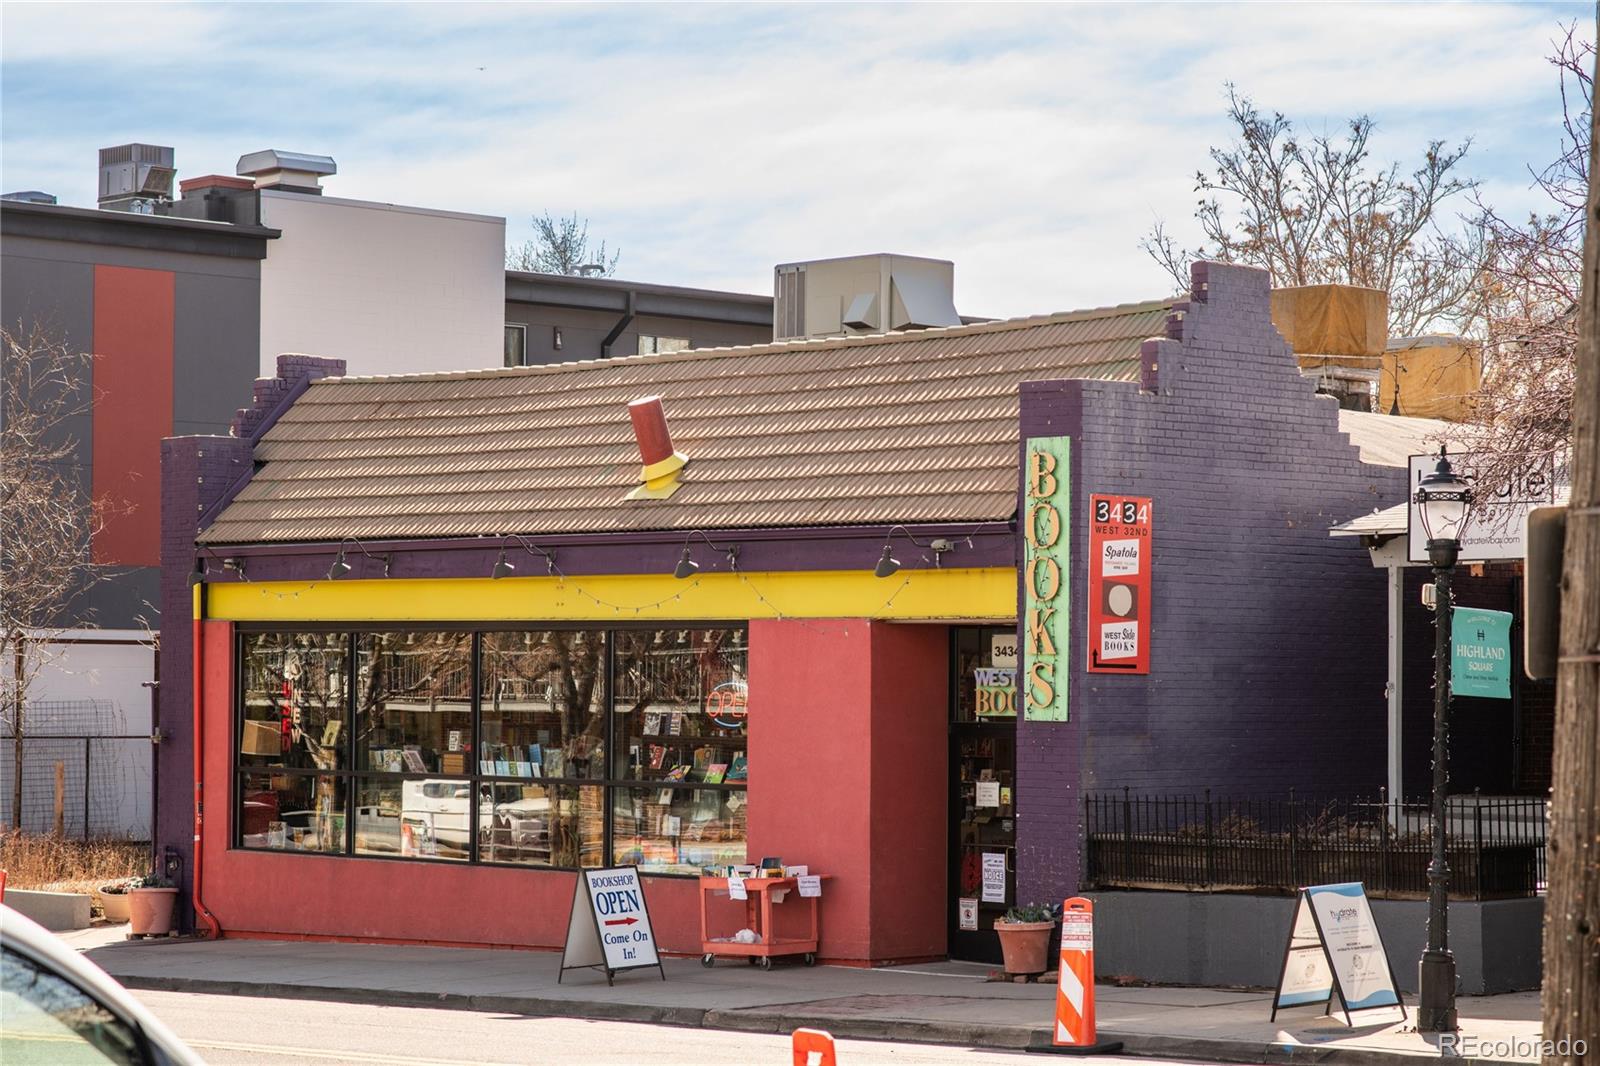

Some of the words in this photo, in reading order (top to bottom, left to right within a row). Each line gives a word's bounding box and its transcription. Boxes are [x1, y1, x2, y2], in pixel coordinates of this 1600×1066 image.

[1096, 501, 1148, 524] 3434
[1095, 526, 1119, 534] WEST
[1124, 527, 1148, 536] 32ND
[1105, 545, 1137, 559] Spatola
[1026, 450, 1062, 709] BOOKS
[1104, 632, 1121, 640] WEST
[1122, 628, 1136, 640] Side
[1104, 640, 1135, 651] BOOKS
[1456, 645, 1505, 660] HIGHLAND
[1468, 661, 1494, 672] SQUARE
[974, 669, 1017, 687] WEST
[591, 874, 634, 888] BOOKSHOP
[596, 889, 640, 915] OPEN
[604, 932, 630, 945] Come
[633, 930, 648, 942] On
[623, 947, 637, 959] In!
